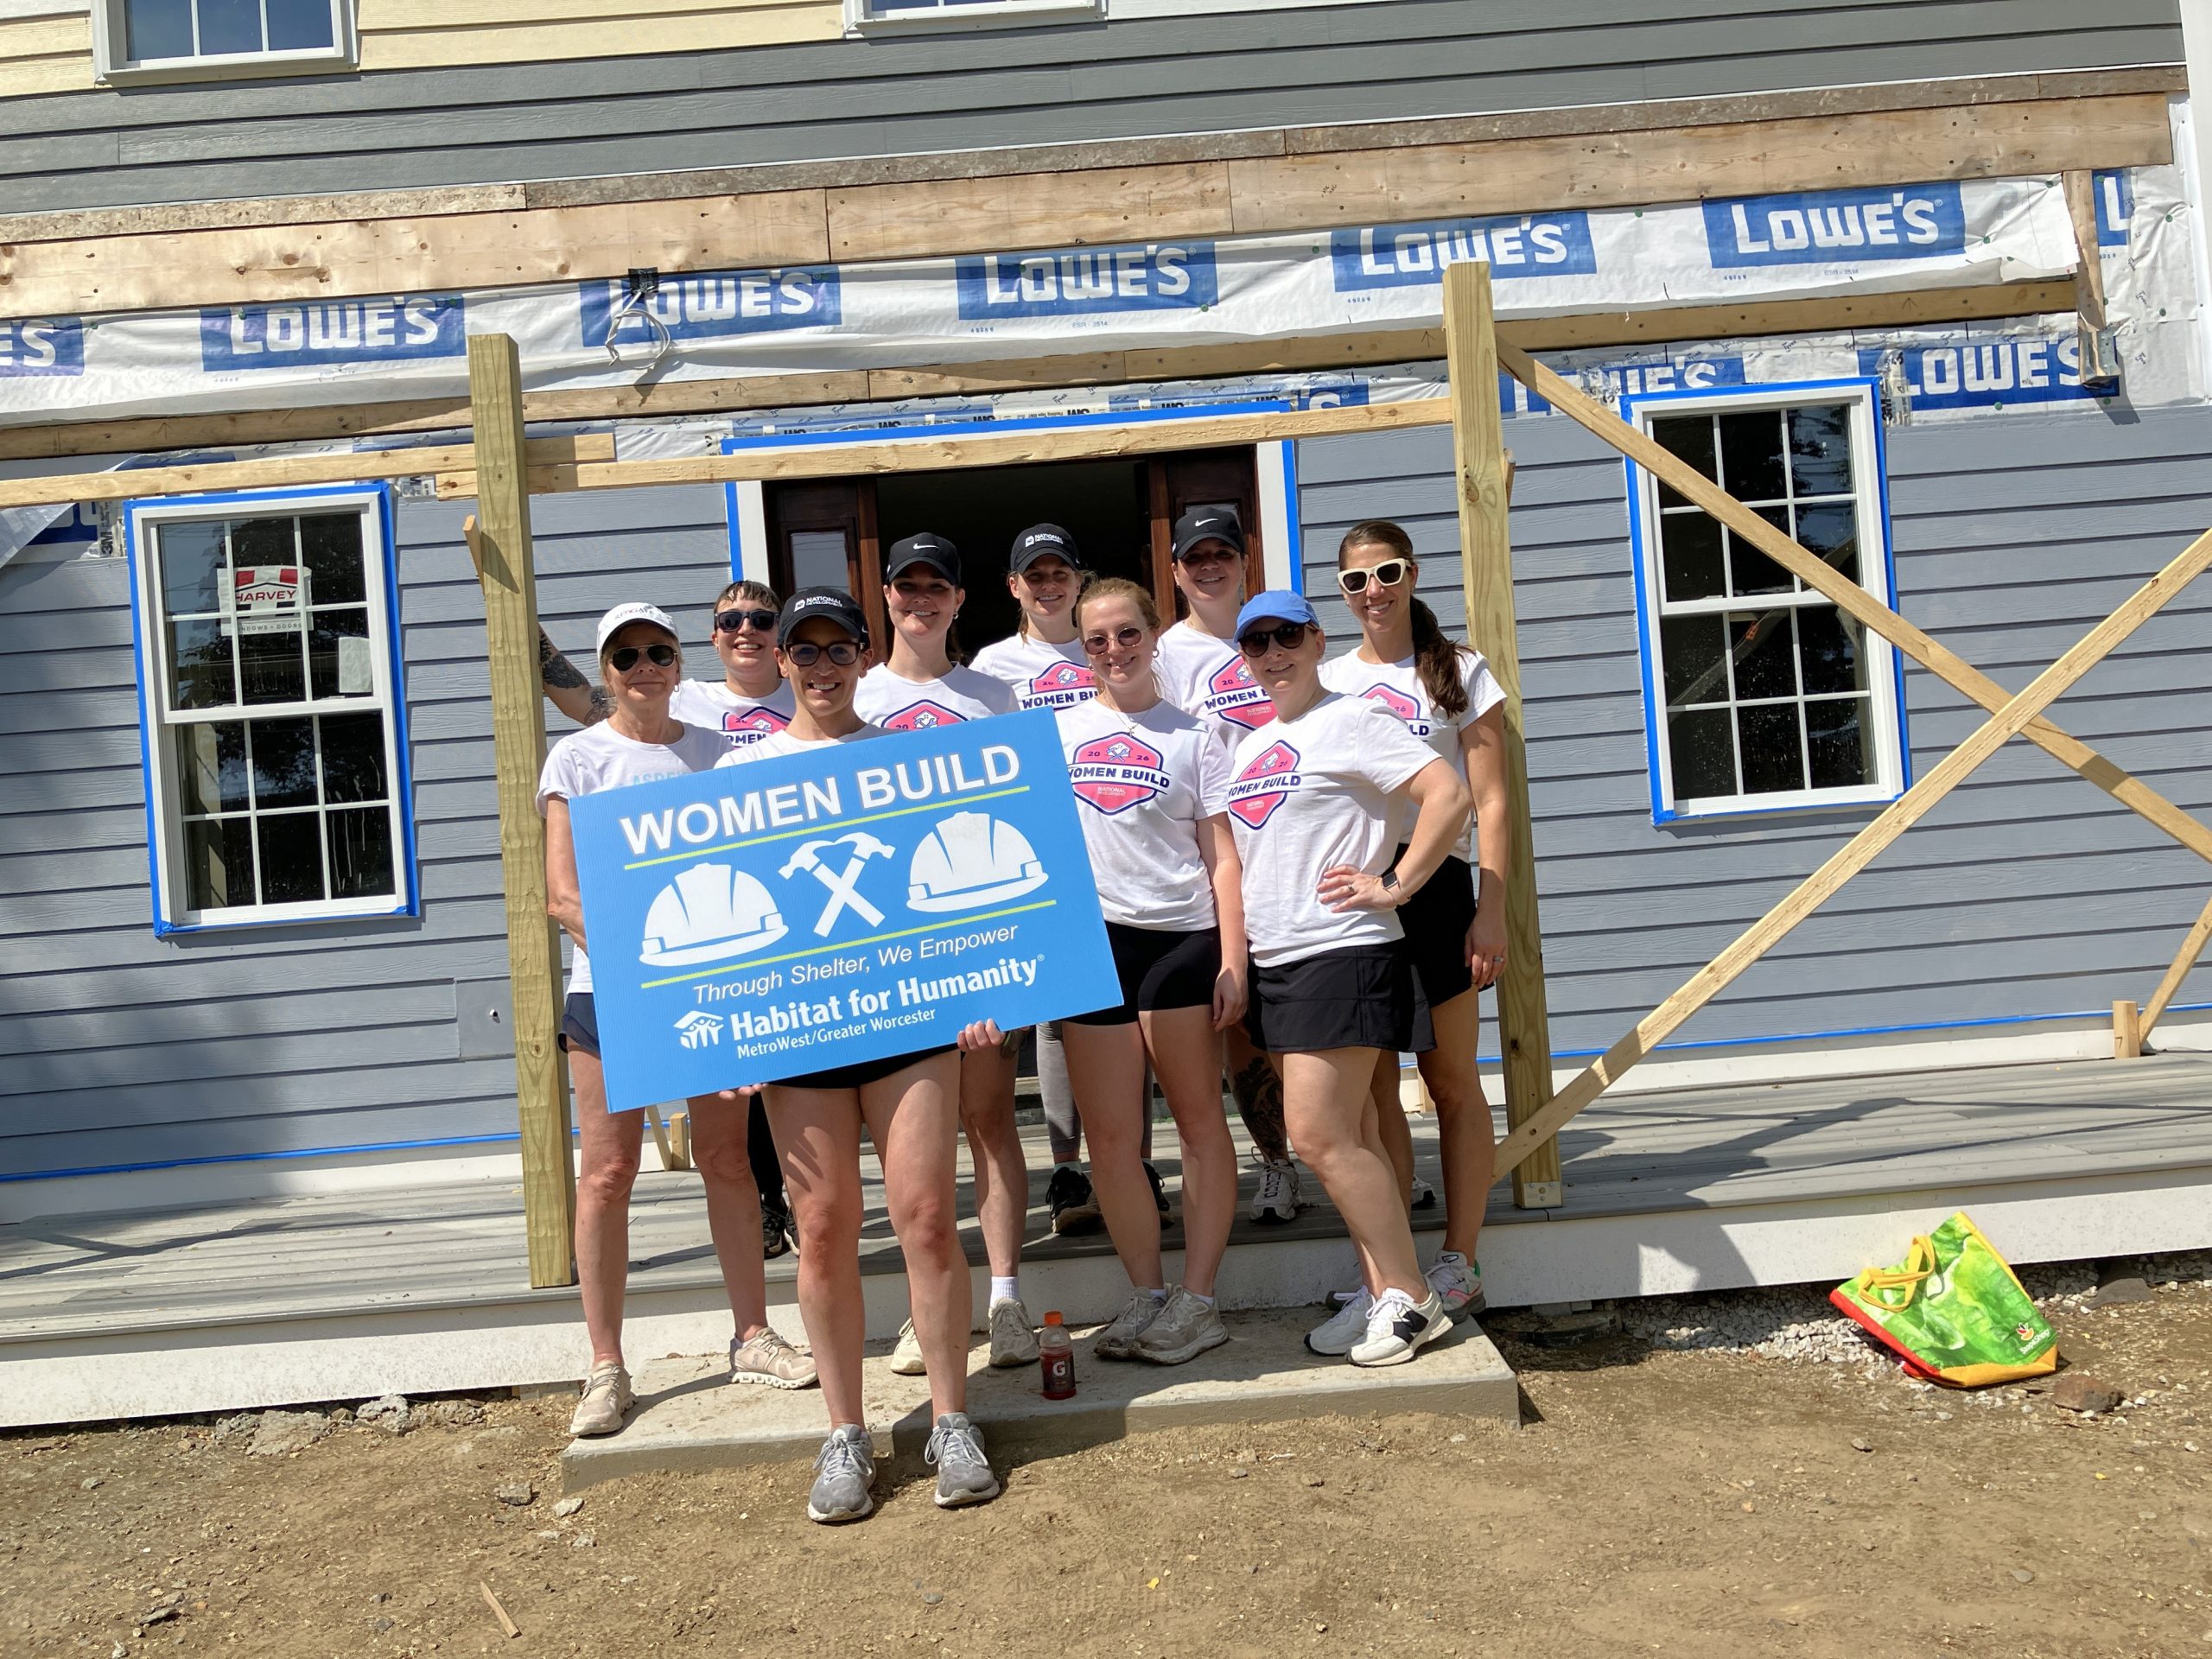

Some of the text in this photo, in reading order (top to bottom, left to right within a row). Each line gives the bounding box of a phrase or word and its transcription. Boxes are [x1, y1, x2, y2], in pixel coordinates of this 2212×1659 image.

[101, 531, 113, 554] 3M
[235, 590, 296, 602] HARVEY
[806, 596, 841, 605] NATIONAL
[1022, 692, 1074, 709] WOMEN
[1205, 690, 1257, 709] WOMEN
[727, 734, 766, 745] OMEN
[1122, 768, 1170, 789] BUILD
[1262, 775, 1301, 790] BUILD
[620, 744, 1021, 855] WOMEN BUILD
[693, 923, 1020, 1005] Through Shelter, We Empower
[730, 1000, 843, 1041] Habitat
[849, 988, 892, 1014] for
[736, 1009, 937, 1059] MetroWest/Greater Worcester
[1052, 1360, 1066, 1376] G
